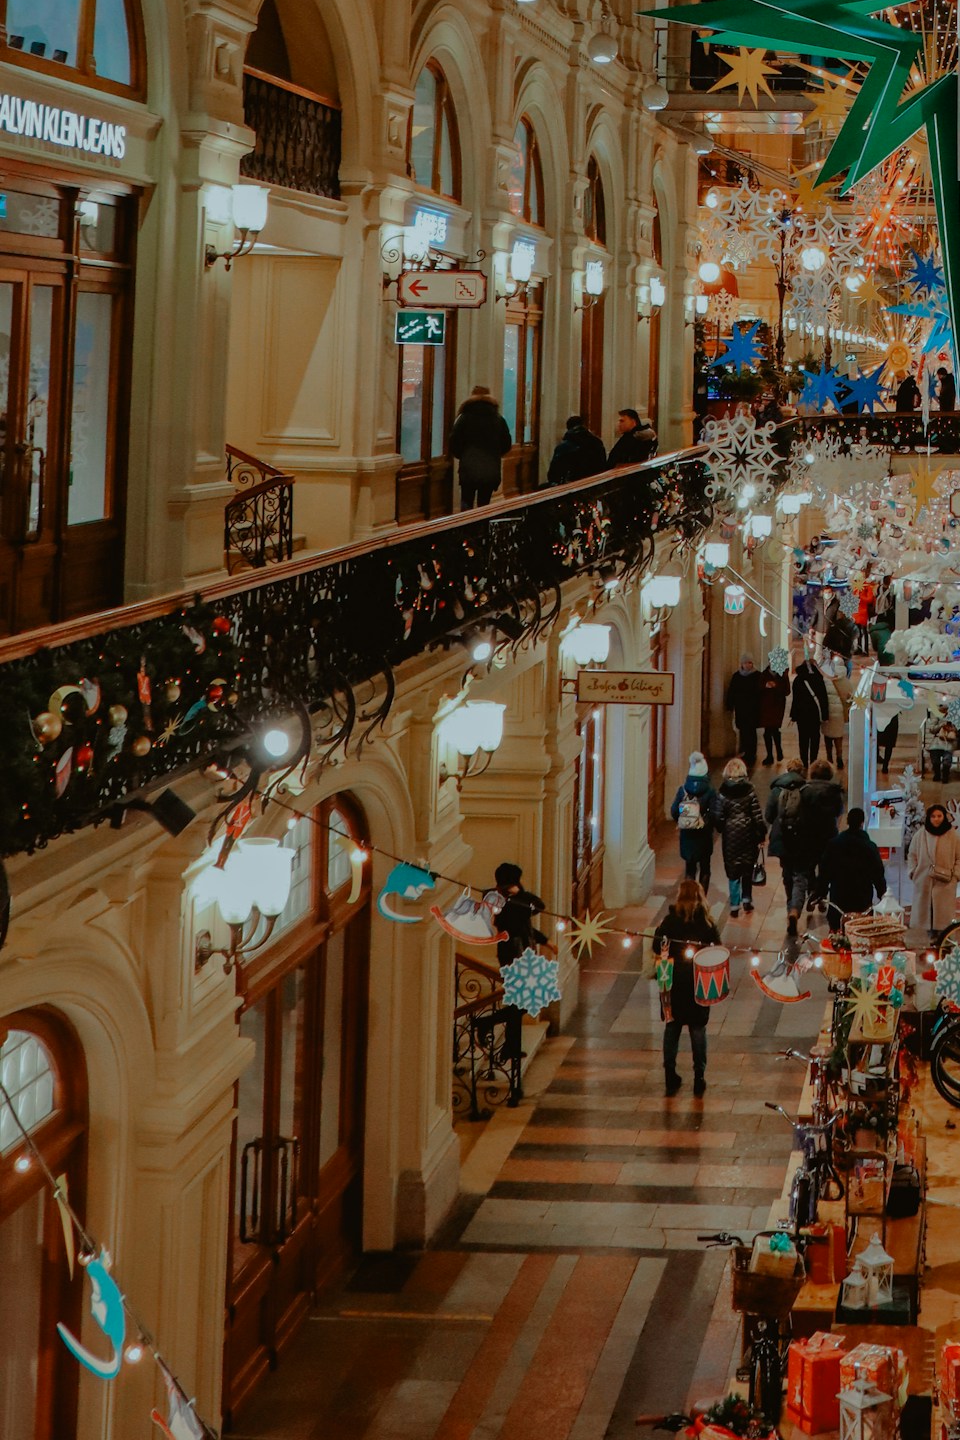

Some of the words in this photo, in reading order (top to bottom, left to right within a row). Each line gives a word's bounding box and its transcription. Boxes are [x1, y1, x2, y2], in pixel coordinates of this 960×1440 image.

[0, 95, 44, 139] ALVIN
[43, 106, 85, 149] KLEIN
[83, 118, 126, 159] JEANS
